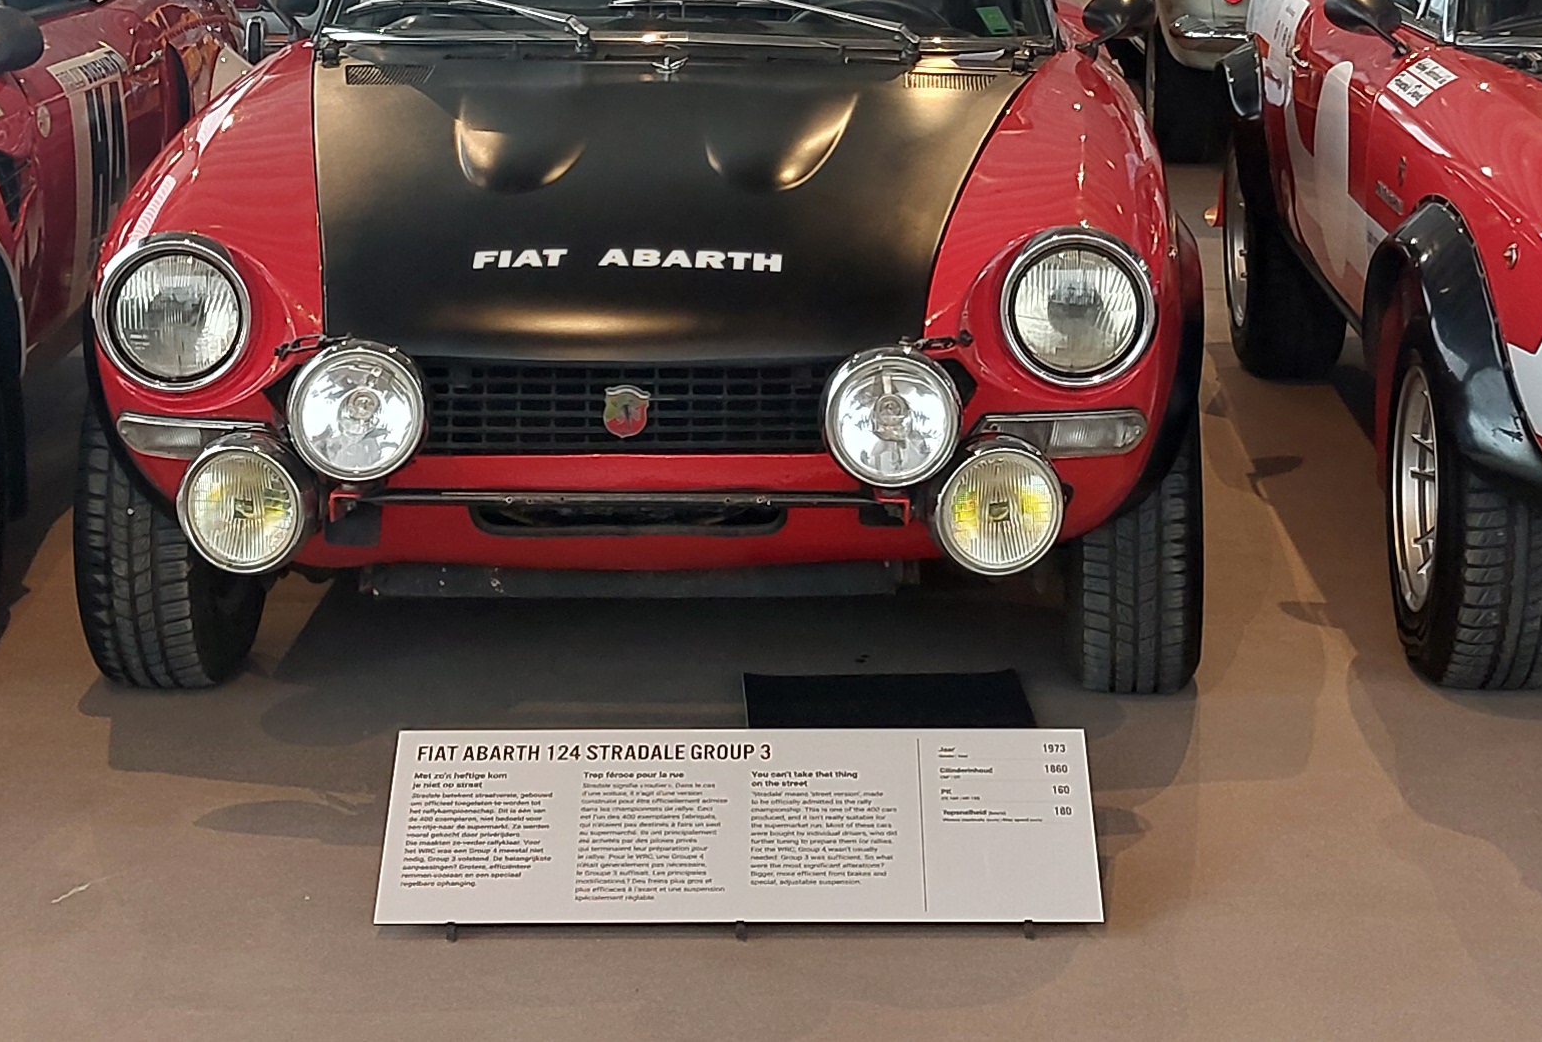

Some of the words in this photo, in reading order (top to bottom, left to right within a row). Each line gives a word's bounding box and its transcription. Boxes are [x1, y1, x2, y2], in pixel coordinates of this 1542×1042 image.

[472, 249, 568, 269] FIAT
[598, 249, 783, 272] ABARTH
[417, 745, 459, 761] FIAT
[462, 745, 540, 761] ABARTH
[547, 745, 581, 761] 124
[586, 745, 685, 761] STRADALE
[691, 745, 755, 761] GROUP
[759, 745, 771, 761] 3
[1043, 744, 1066, 753] 1973
[1044, 764, 1068, 774] 1860
[751, 771, 769, 779] You
[770, 771, 792, 779] can't
[794, 771, 813, 779] take
[815, 771, 833, 779] that
[834, 771, 858, 779] thing
[751, 780, 763, 788] on
[765, 780, 780, 788] the
[781, 780, 808, 788] street
[1052, 785, 1070, 794] 160
